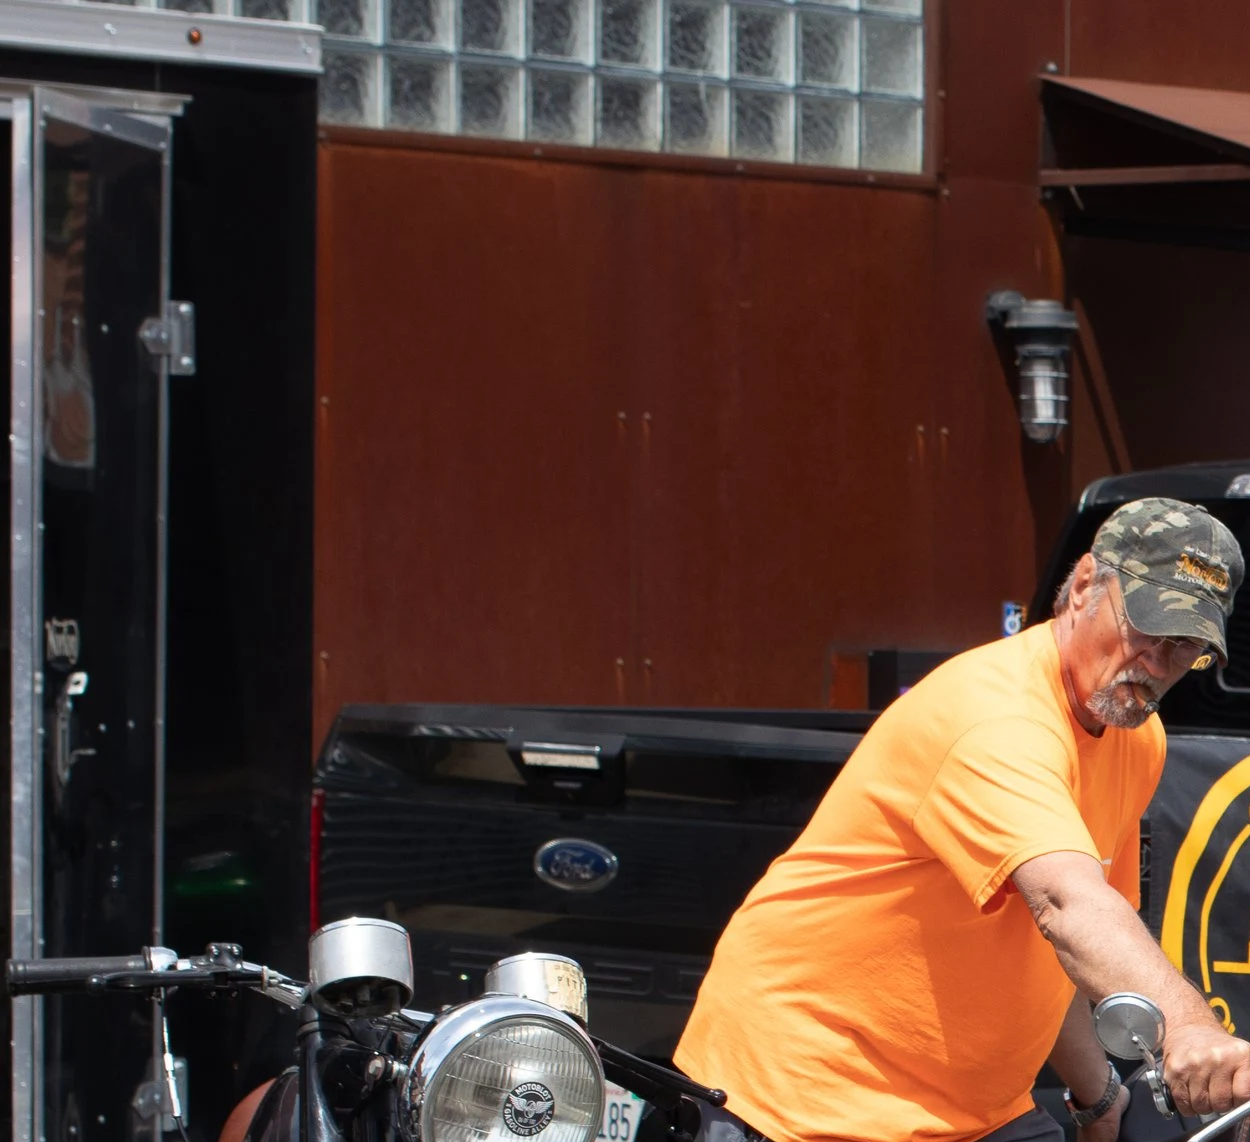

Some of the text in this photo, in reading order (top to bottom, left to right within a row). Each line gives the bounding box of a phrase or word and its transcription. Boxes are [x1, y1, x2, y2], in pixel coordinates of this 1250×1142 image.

[550, 850, 594, 879] Ford
[514, 1083, 551, 1100] MOTOBLOT
[504, 1108, 551, 1135] GASOLINE ALLEY
